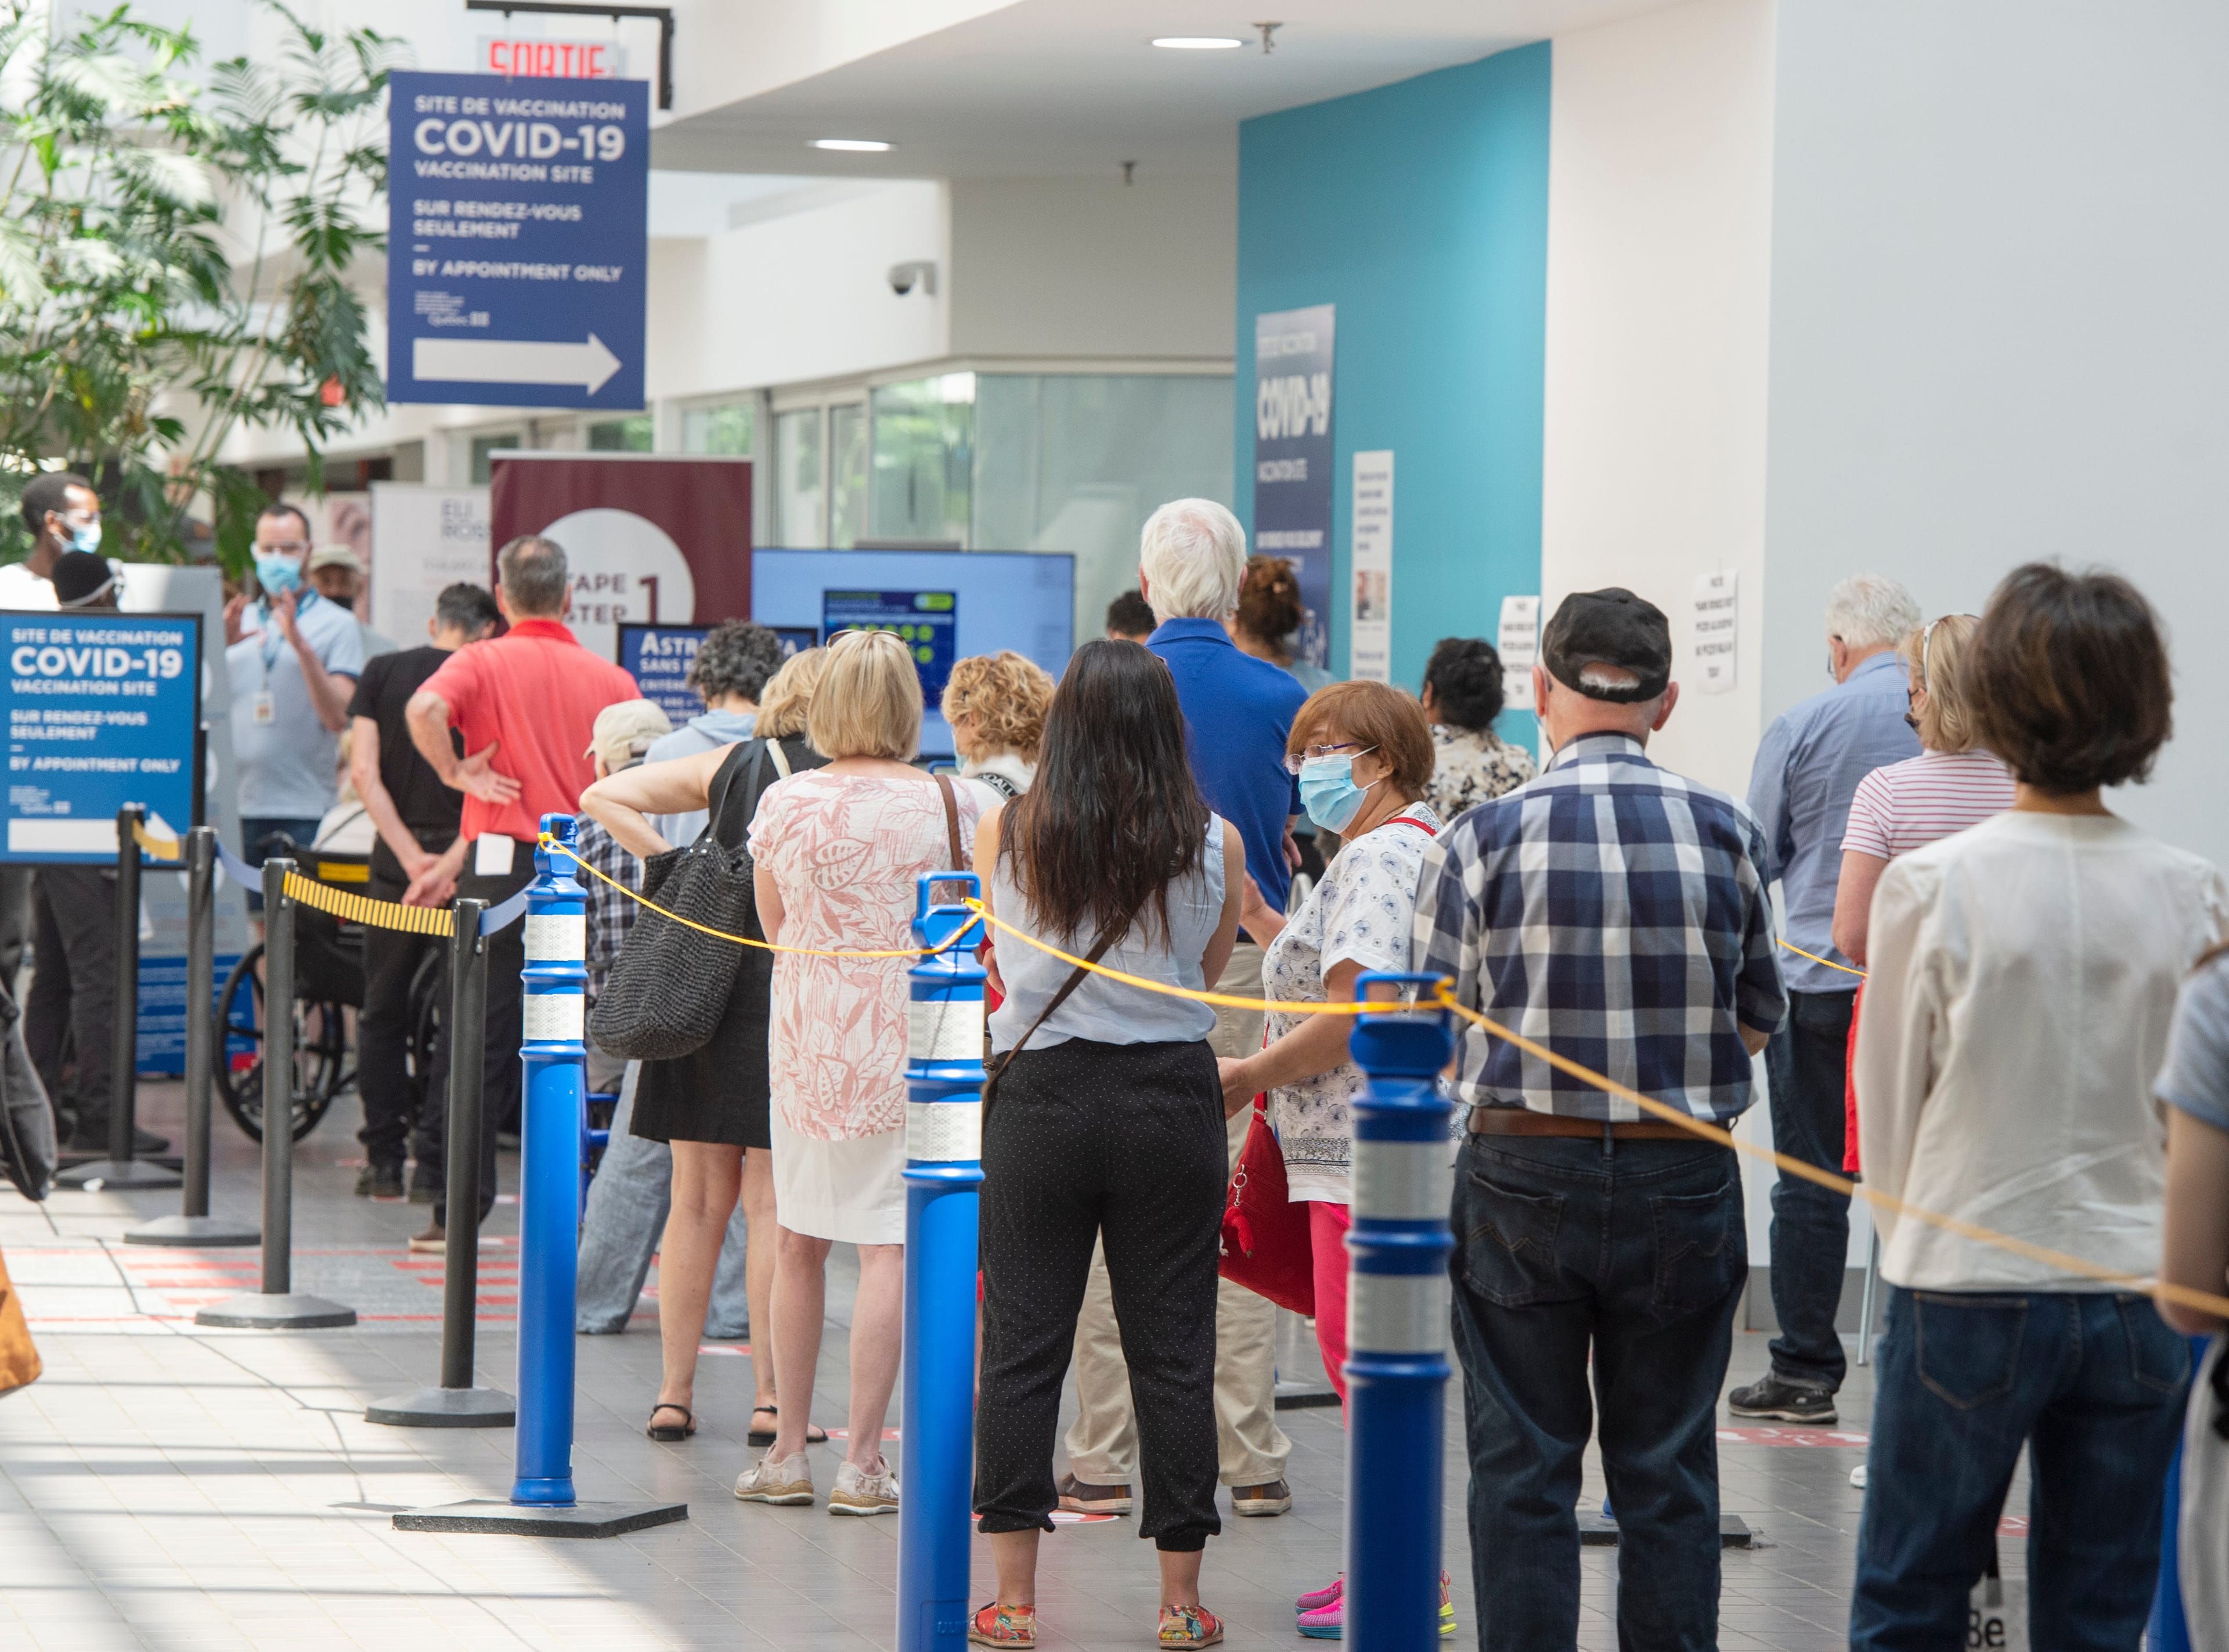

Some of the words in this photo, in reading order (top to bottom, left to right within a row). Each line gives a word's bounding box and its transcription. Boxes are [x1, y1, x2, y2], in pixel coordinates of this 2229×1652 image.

[489, 39, 604, 79] SORTIE
[414, 96, 457, 114] SITE
[462, 97, 489, 115] DE
[493, 99, 626, 120] VACCINATION
[414, 118, 625, 161] COVID-19
[414, 161, 547, 181] VACCINATION
[551, 165, 593, 183] SITE
[413, 200, 451, 217] SUR
[454, 201, 582, 221] RENDEZ-VOUS
[413, 219, 520, 239] SEULEMENT
[413, 259, 438, 276] BY
[441, 261, 571, 280] APPOINTMENT
[574, 265, 623, 283] ONLY
[12, 628, 46, 644] SITE
[49, 629, 72, 644] DE
[75, 630, 183, 647] VACCINATION
[10, 646, 183, 679] COVID-19
[11, 679, 120, 695] VACCINATION
[122, 681, 157, 696] SITE
[10, 709, 41, 724] SUR
[43, 710, 148, 726] RENDEZ-VOUS
[10, 725, 98, 740] SEULEMENT
[9, 756, 31, 771] BY
[33, 756, 139, 773] APPOINTMENT
[139, 759, 181, 773] ONLY
